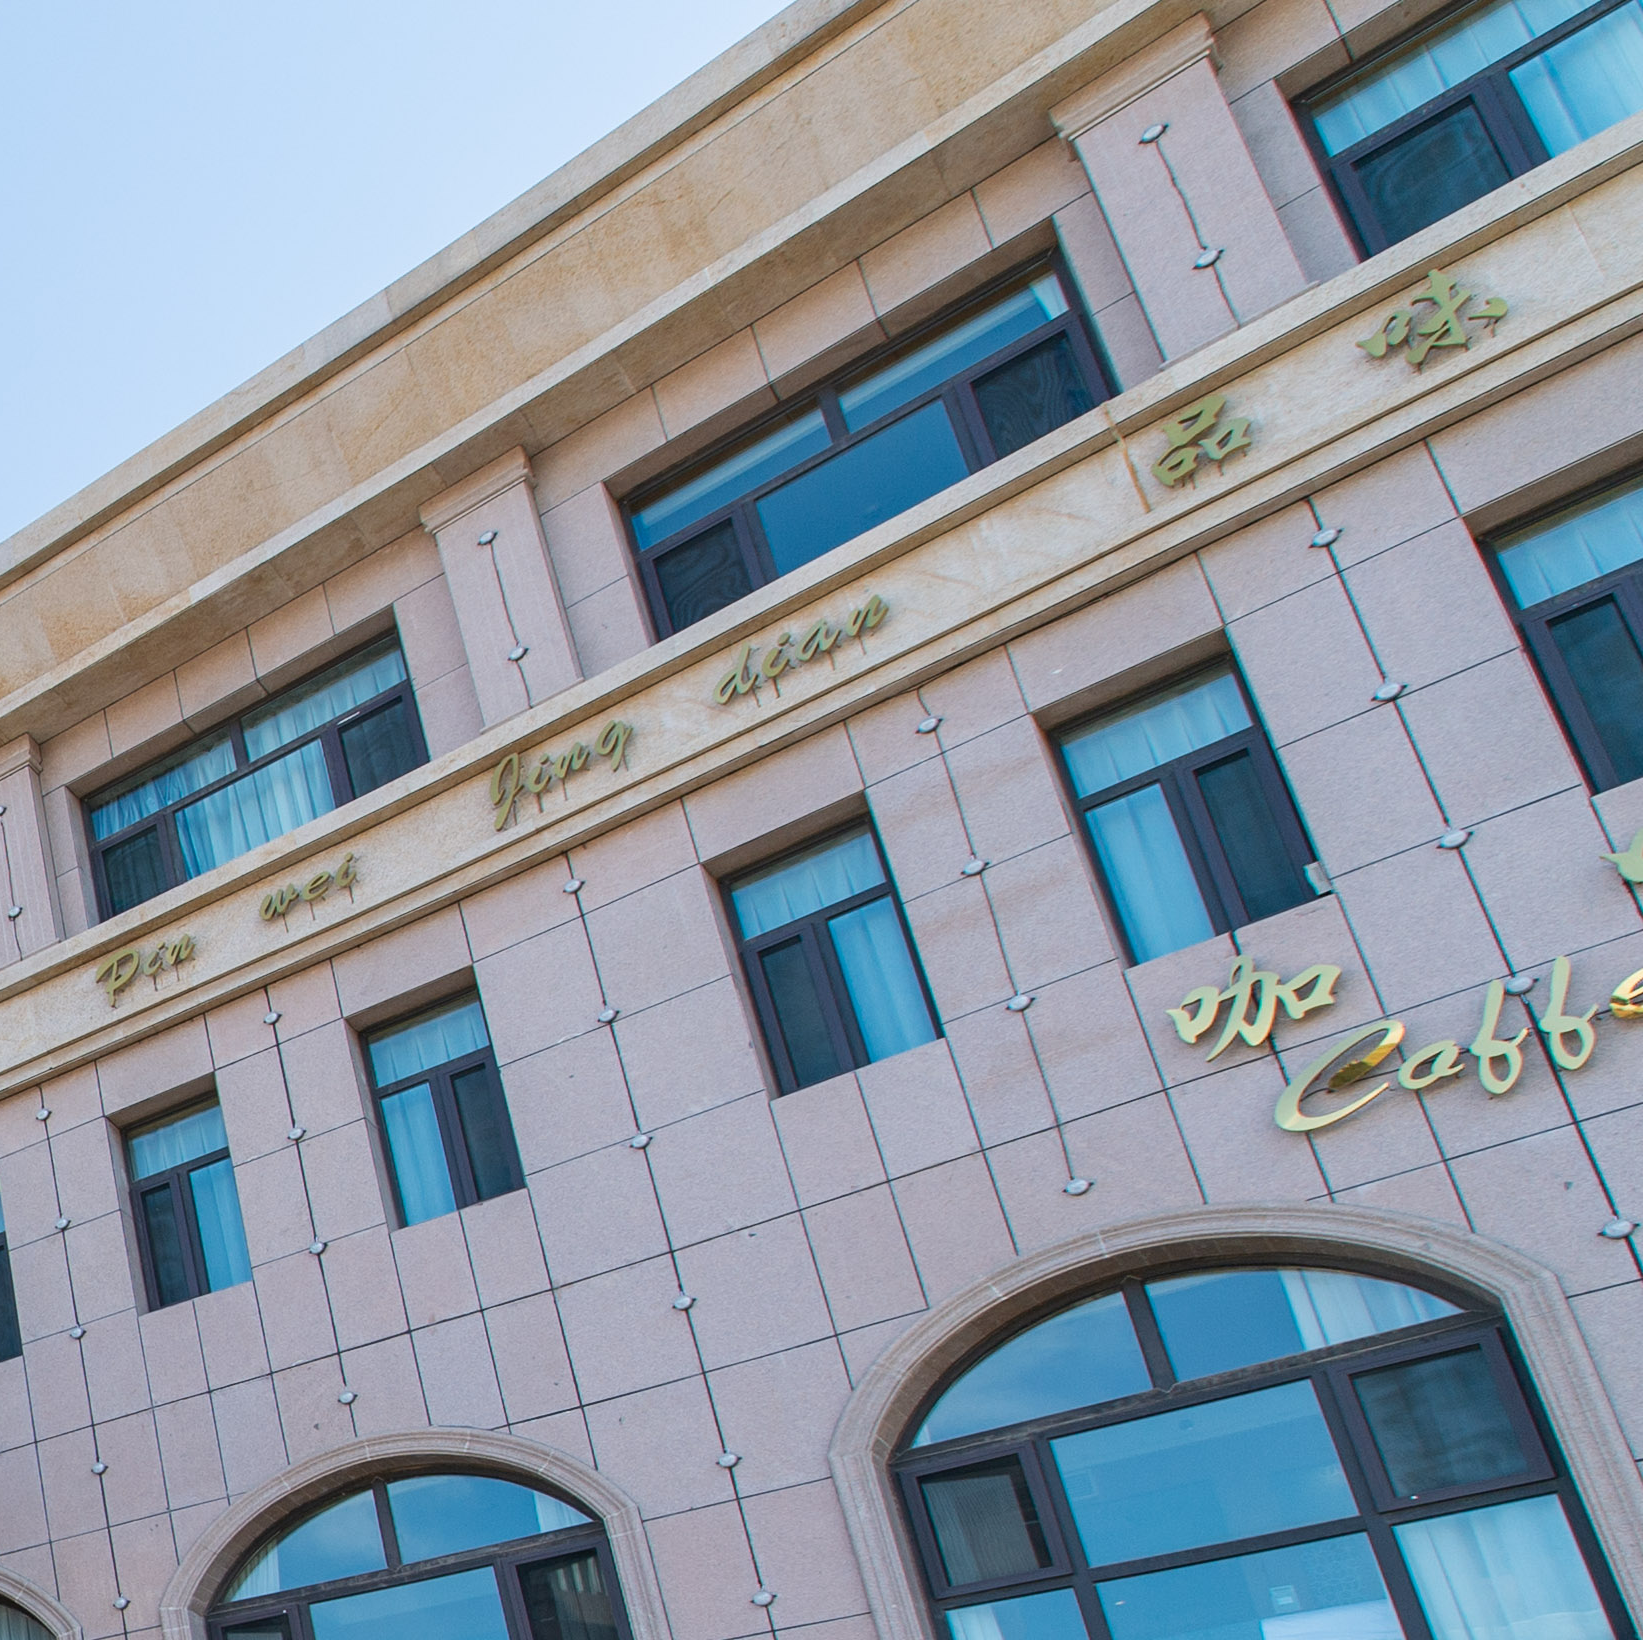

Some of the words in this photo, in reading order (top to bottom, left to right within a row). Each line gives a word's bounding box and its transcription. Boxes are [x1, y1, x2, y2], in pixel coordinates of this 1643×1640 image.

[94, 929, 198, 998] Pin
[258, 853, 358, 922] wei
[488, 716, 633, 831] Jing
[712, 592, 890, 706] dian
